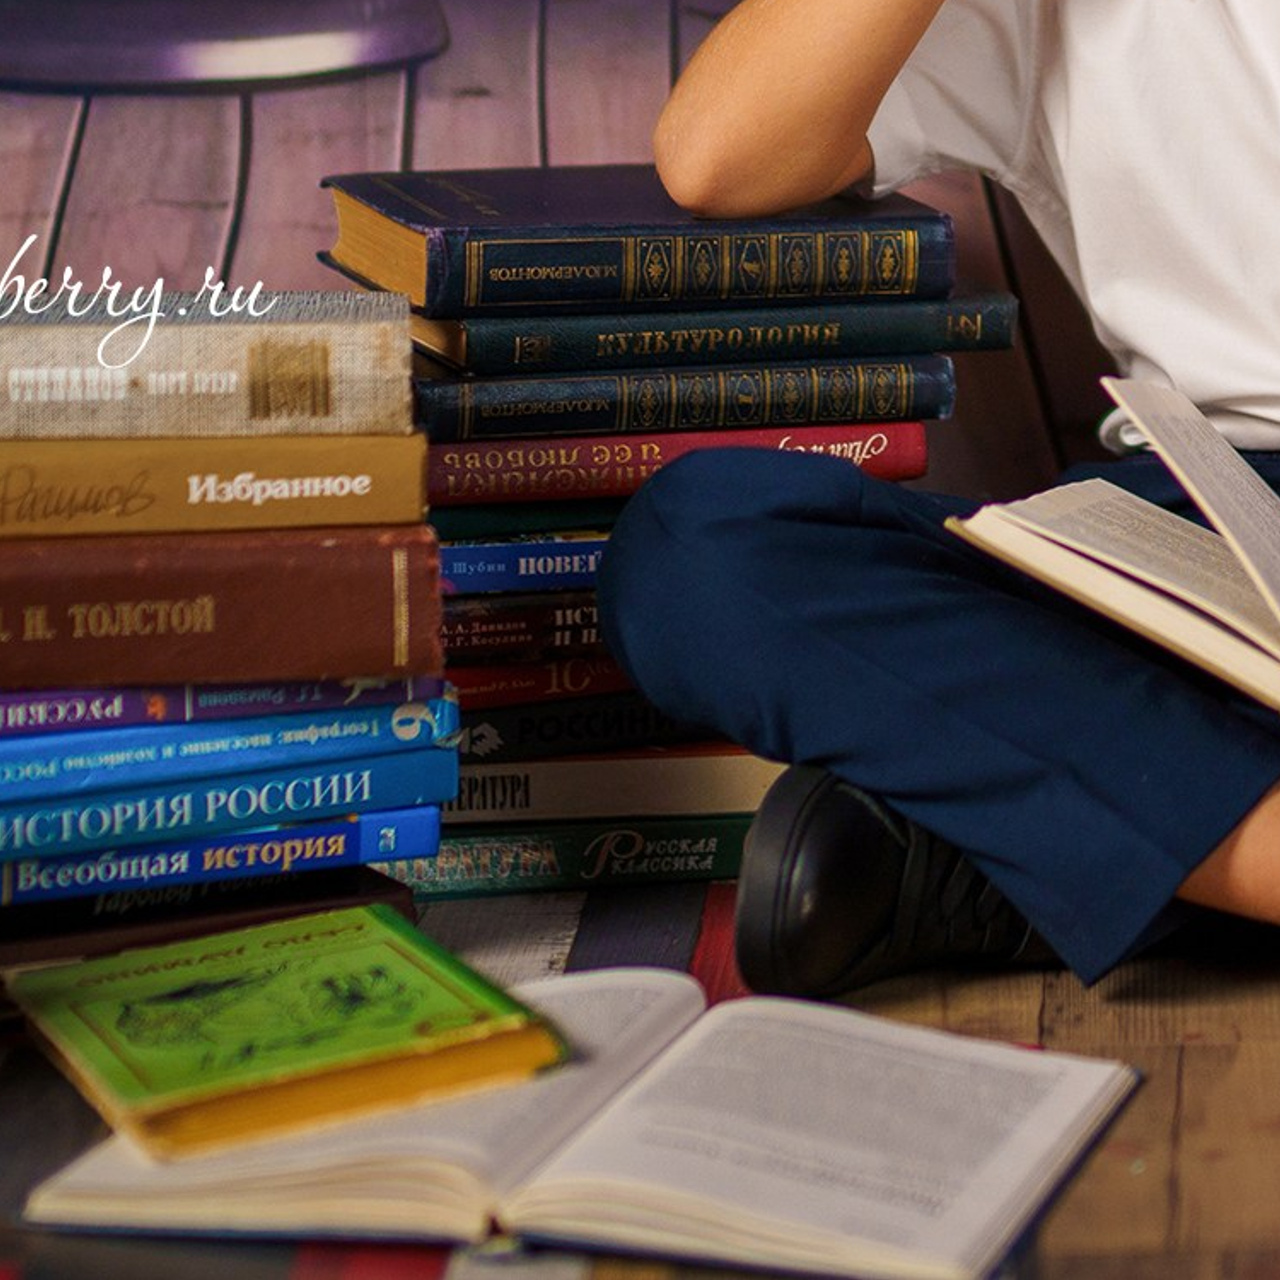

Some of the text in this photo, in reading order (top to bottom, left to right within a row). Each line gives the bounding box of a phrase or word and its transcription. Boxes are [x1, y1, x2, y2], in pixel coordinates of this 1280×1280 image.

[596, 322, 842, 358] КУЛЬТУРОЛОГИЯ
[187, 472, 372, 506] Избранное
[69, 595, 216, 639] ТОЛСТОЙ
[0, 770, 372, 849] ИСТОРИЯ РОССИИ
[16, 832, 347, 893] Всеобщая история
